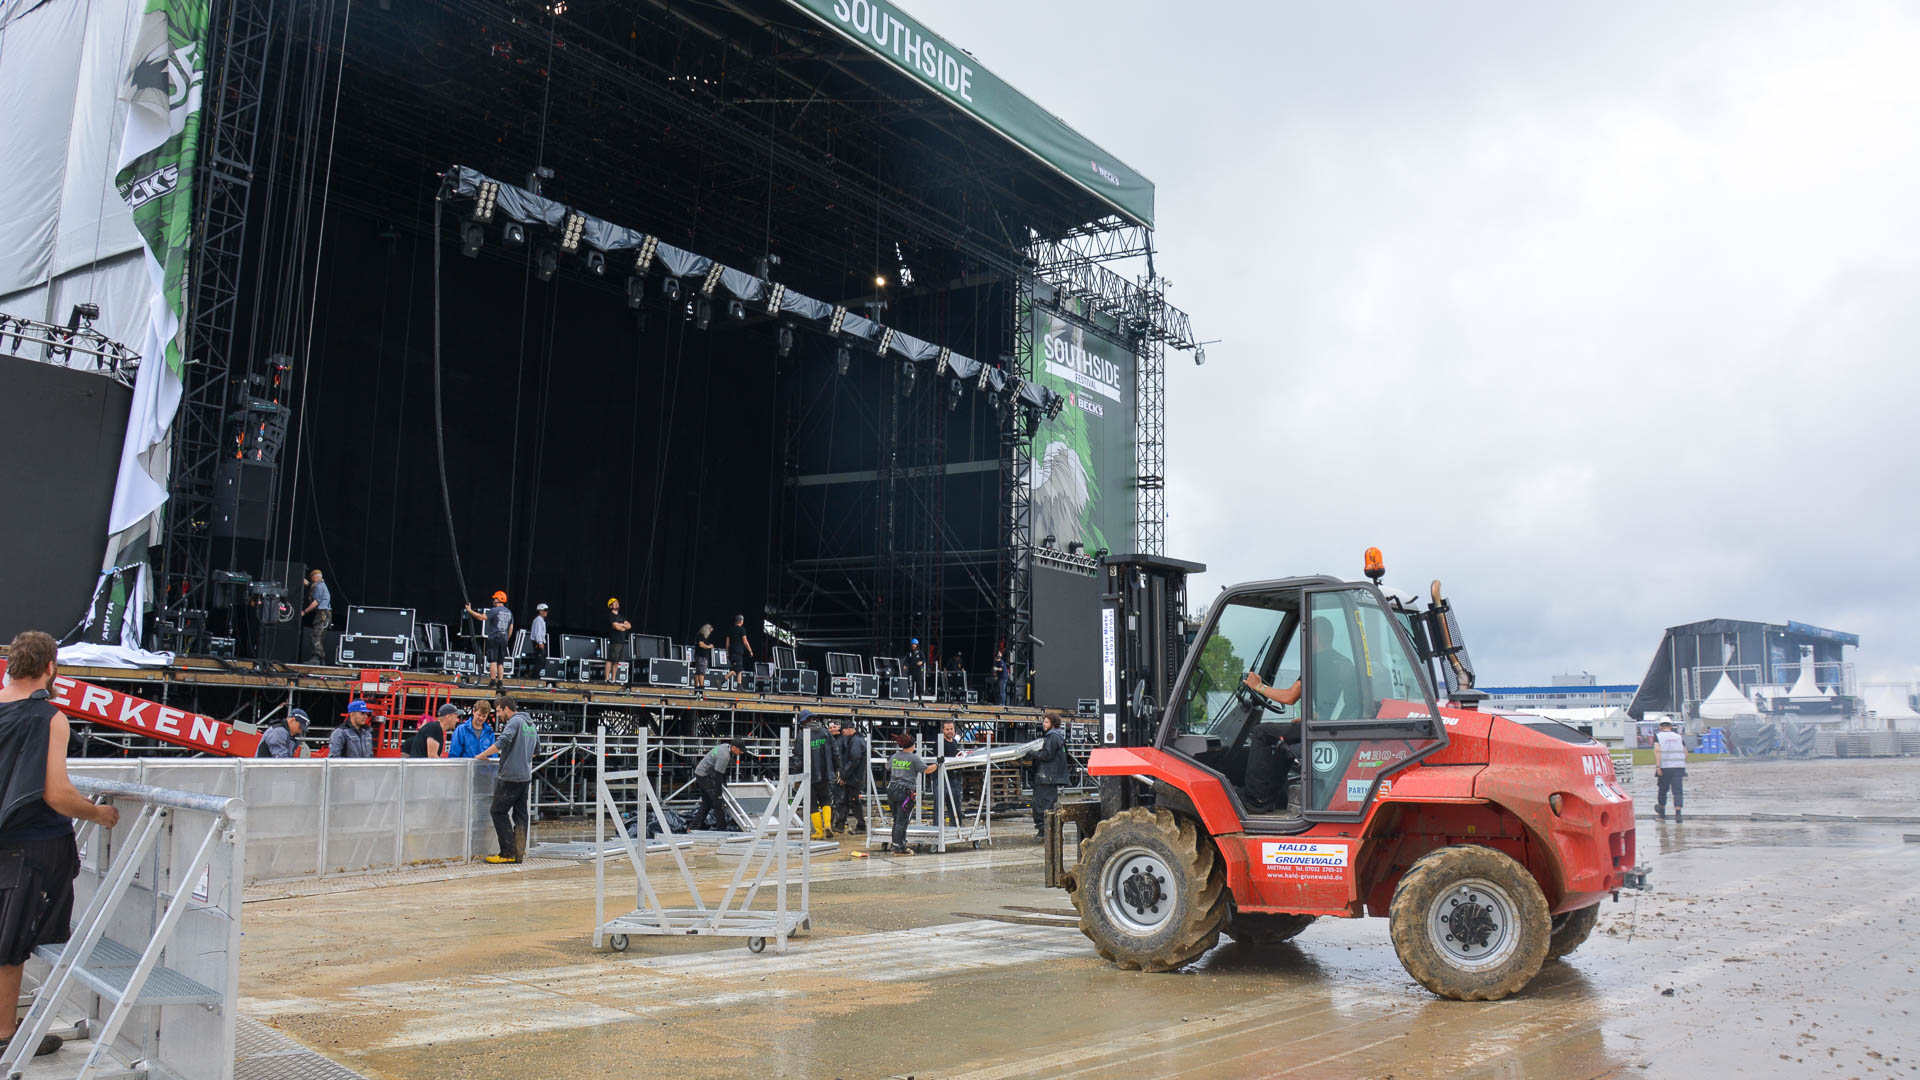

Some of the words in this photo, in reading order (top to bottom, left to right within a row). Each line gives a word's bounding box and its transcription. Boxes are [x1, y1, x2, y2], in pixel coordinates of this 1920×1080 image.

[833, 0, 973, 103] SOUTHSIDE
[1043, 333, 1121, 389] SOUTHSIDE
[1075, 371, 1097, 390] FESTIVAL
[1314, 747, 1333, 764] 20
[1359, 750, 1407, 761] M30-4
[1278, 844, 1307, 852] HALD
[1309, 844, 1317, 852] &
[1275, 856, 1343, 866] GRUNEWALD
[1267, 872, 1343, 881] www.hald-grunewald.de
